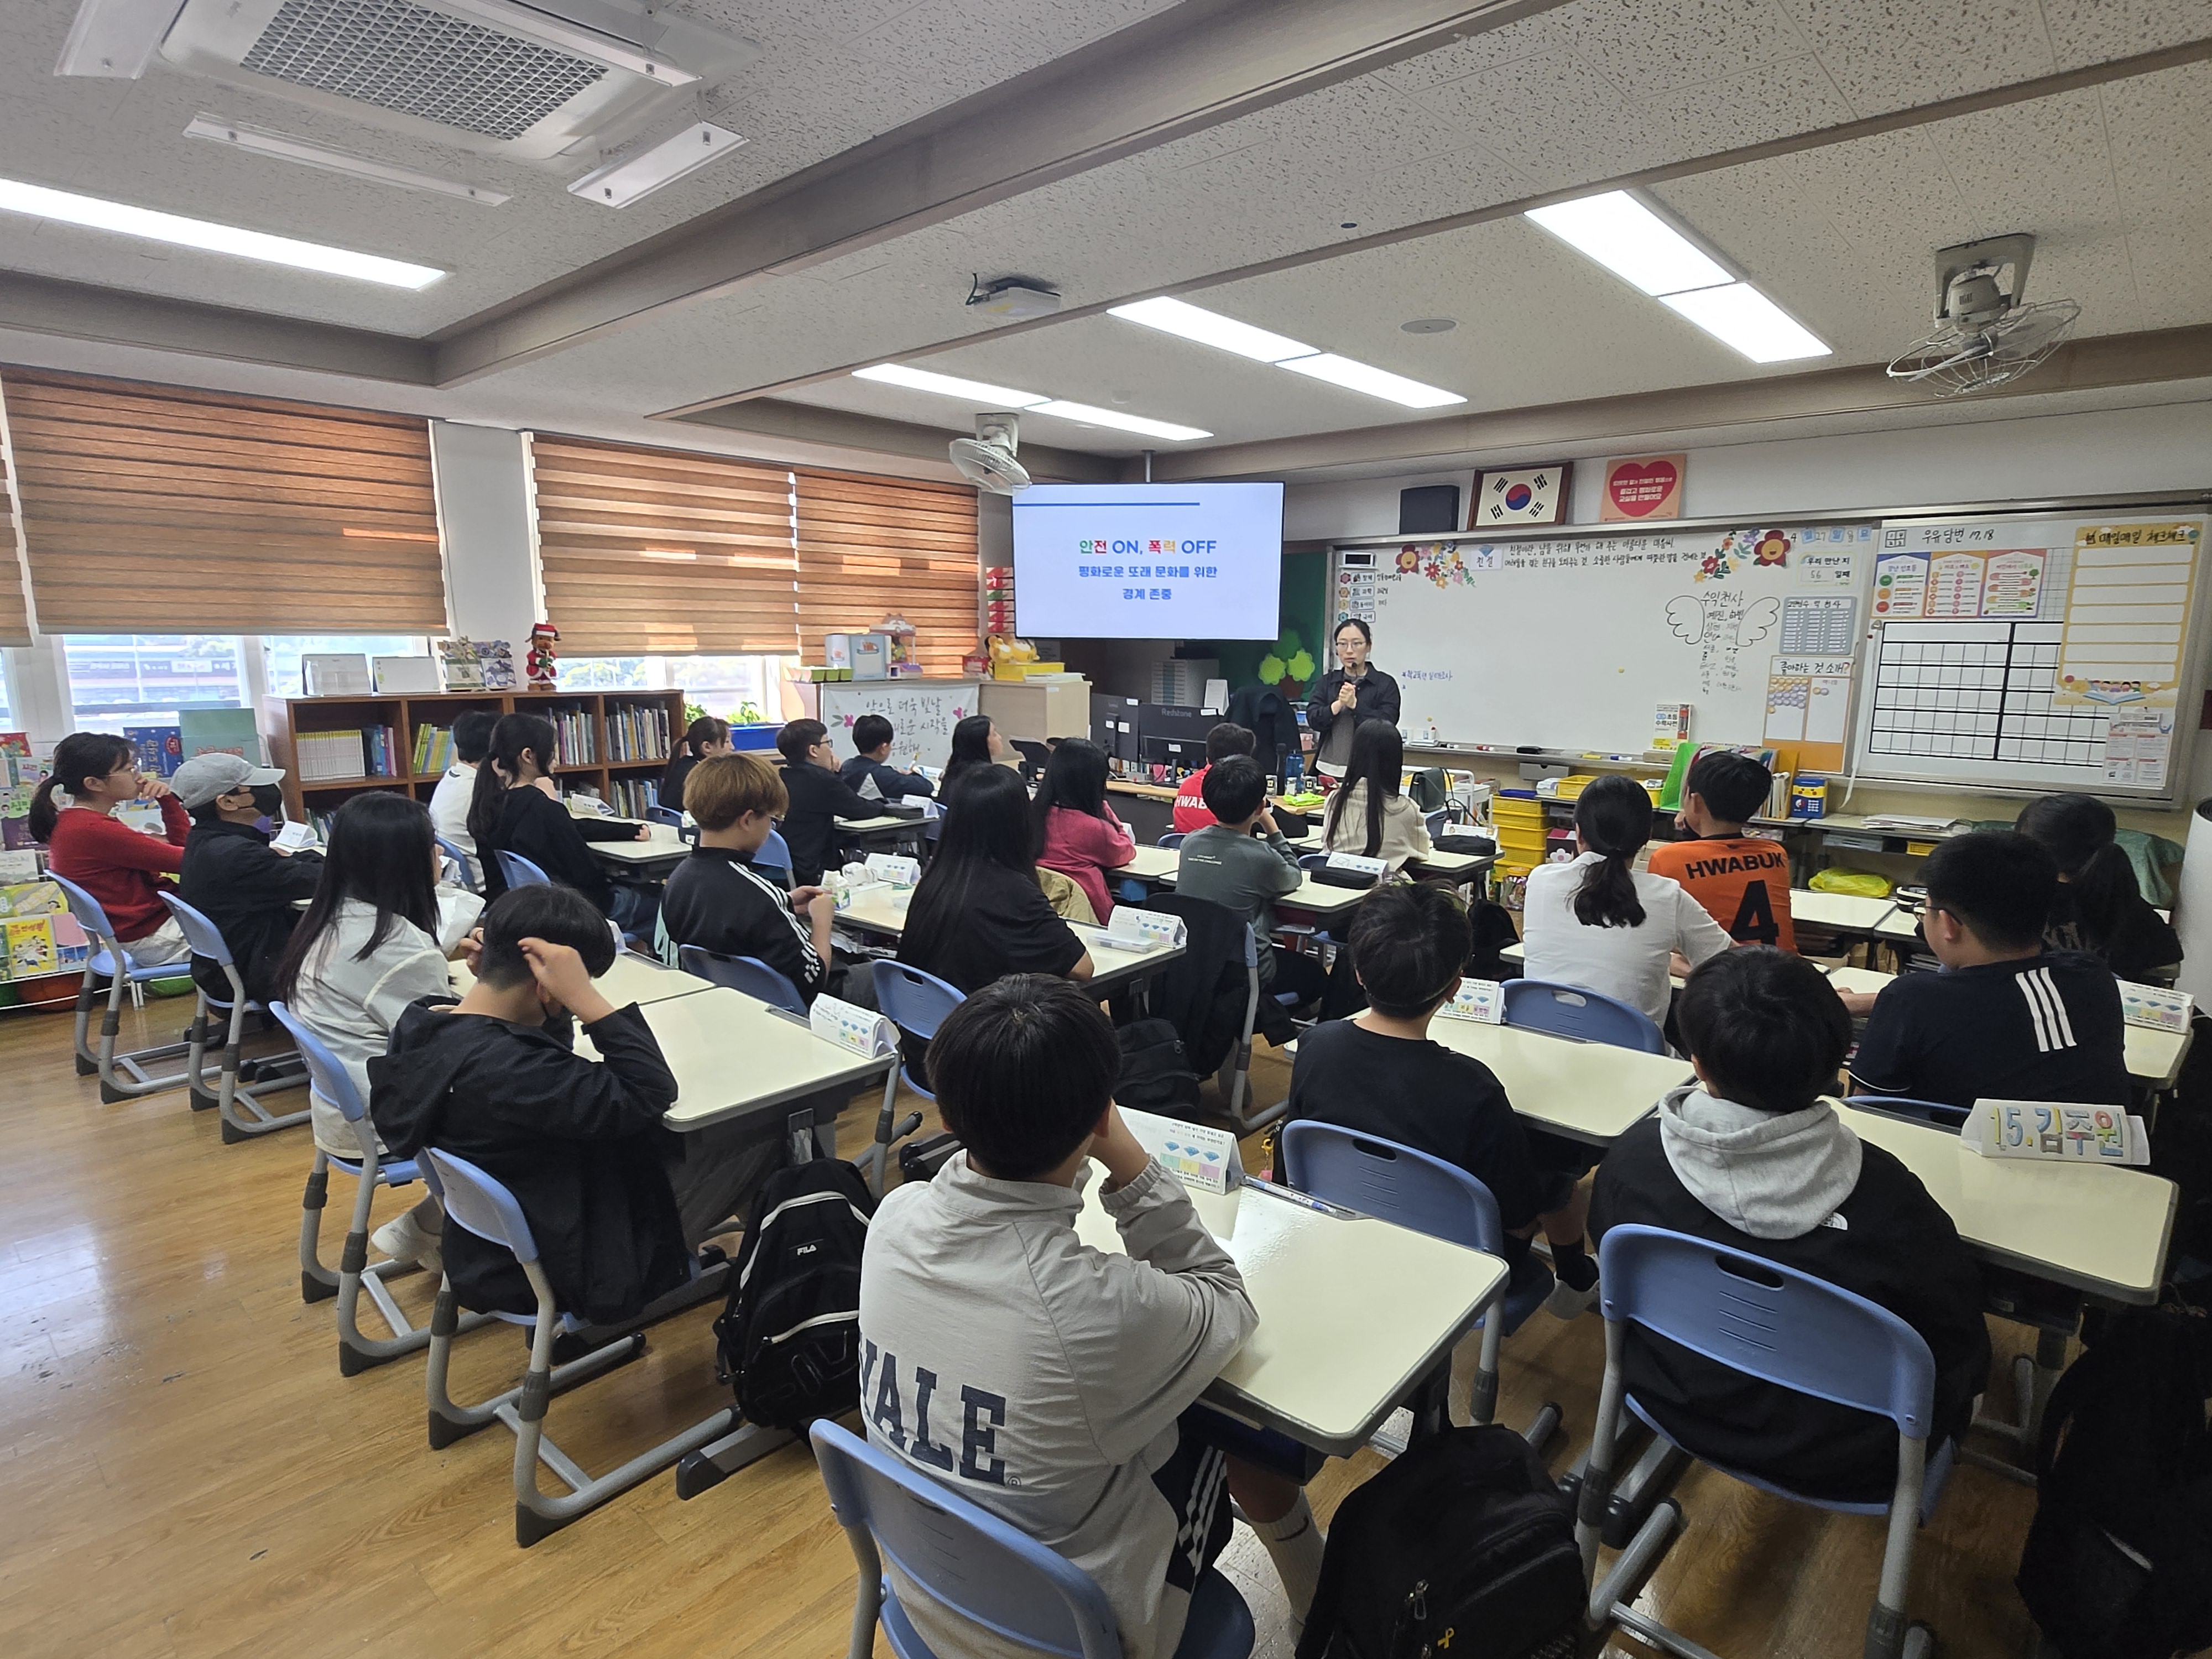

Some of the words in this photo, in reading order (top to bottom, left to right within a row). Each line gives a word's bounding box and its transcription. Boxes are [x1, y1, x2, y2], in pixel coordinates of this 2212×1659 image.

[1079, 540, 1107, 554] 안전
[1149, 539, 1176, 554] 폭력
[1182, 540, 1217, 554] OFF
[1477, 556, 1493, 568] 친절
[1807, 557, 1822, 565] 우리
[1824, 557, 1840, 565] 만난
[1079, 566, 1124, 578] 평화로운
[1129, 566, 1151, 578] 또래
[1155, 566, 1190, 578] 문화를
[1194, 566, 1217, 578] 위한
[1811, 570, 1822, 579] 56
[1835, 570, 1850, 578] 일째
[1123, 588, 1145, 600] 경계
[1149, 588, 1171, 600] 존중
[1780, 661, 1810, 675] 좋아하는
[1814, 662, 1824, 674] 것
[1162, 707, 1192, 718] Redstone
[920, 717, 948, 735] 시작을
[1686, 852, 1785, 879] HWABUK
[1730, 879, 1779, 945] 4
[797, 1245, 816, 1256] FILA
